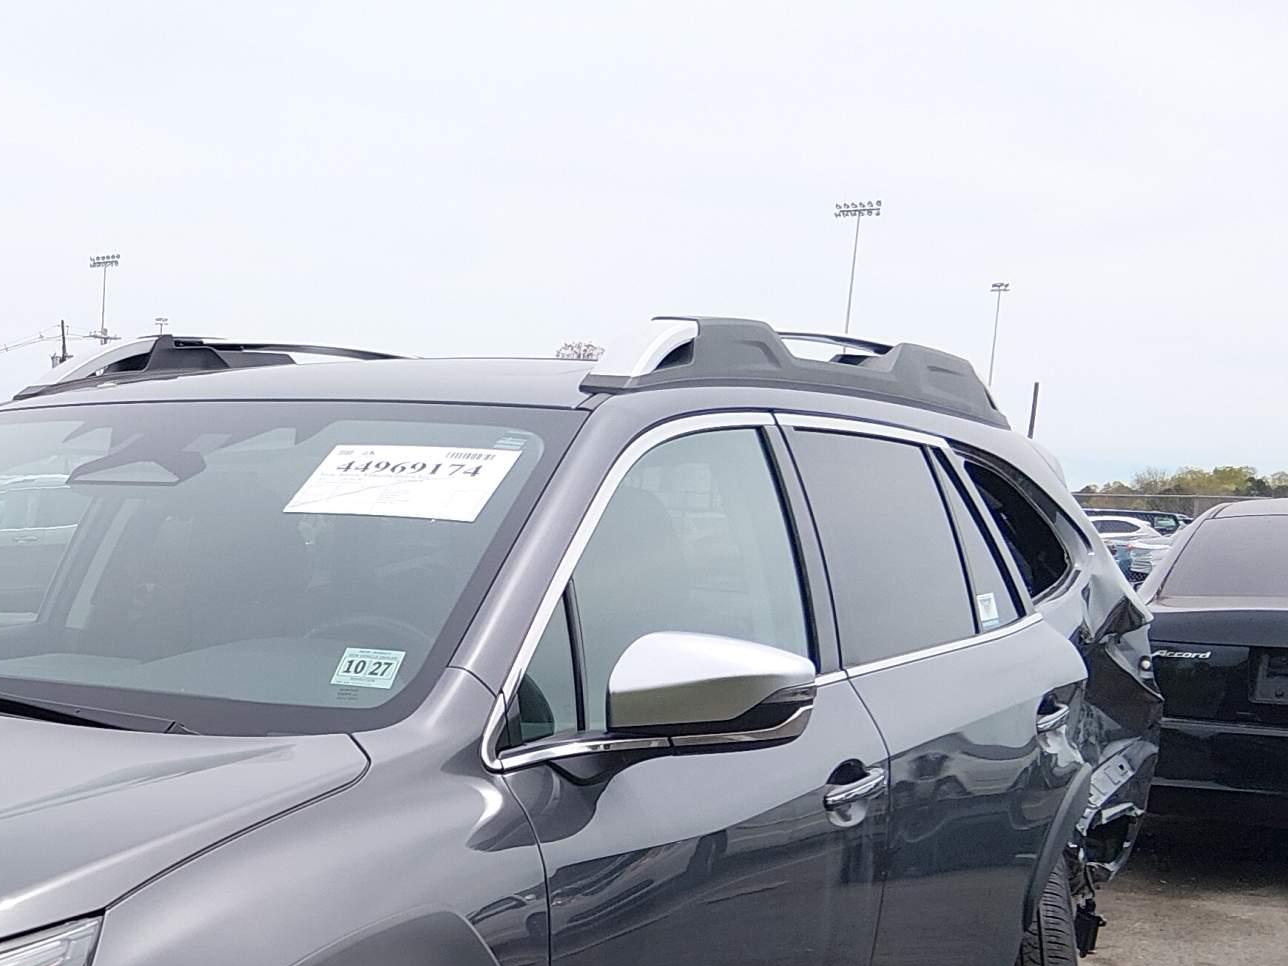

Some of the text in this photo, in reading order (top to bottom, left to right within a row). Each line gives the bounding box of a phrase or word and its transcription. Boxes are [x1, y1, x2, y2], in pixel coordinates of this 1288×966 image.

[336, 461, 483, 477] 44969174
[1152, 649, 1212, 659] Accord
[343, 660, 395, 677] 10 27
